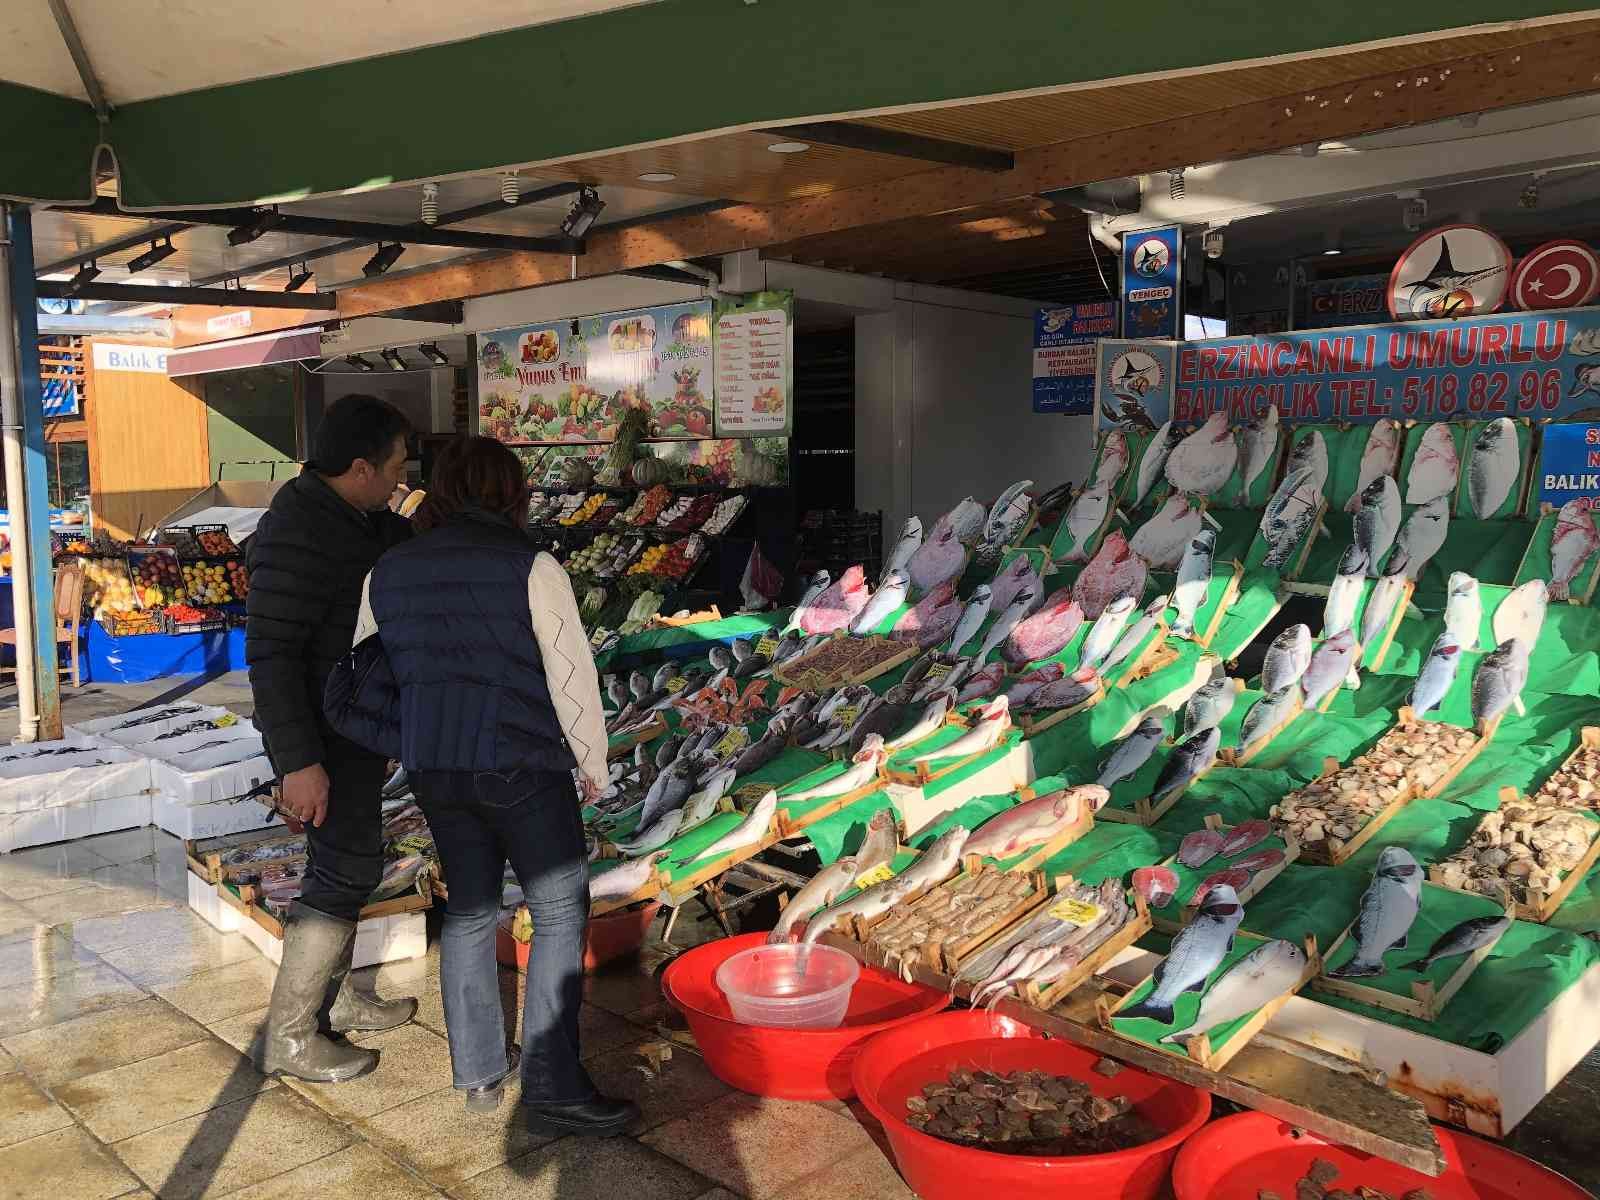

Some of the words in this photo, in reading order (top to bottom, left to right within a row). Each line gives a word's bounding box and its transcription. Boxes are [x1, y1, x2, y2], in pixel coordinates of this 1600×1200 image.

[1387, 319, 1568, 371] UMURLU
[515, 366, 556, 390] Yunus
[1331, 378, 1393, 417] TEL:
[1401, 372, 1460, 416] 518
[1467, 370, 1510, 413] 82
[1519, 368, 1562, 412] 96
